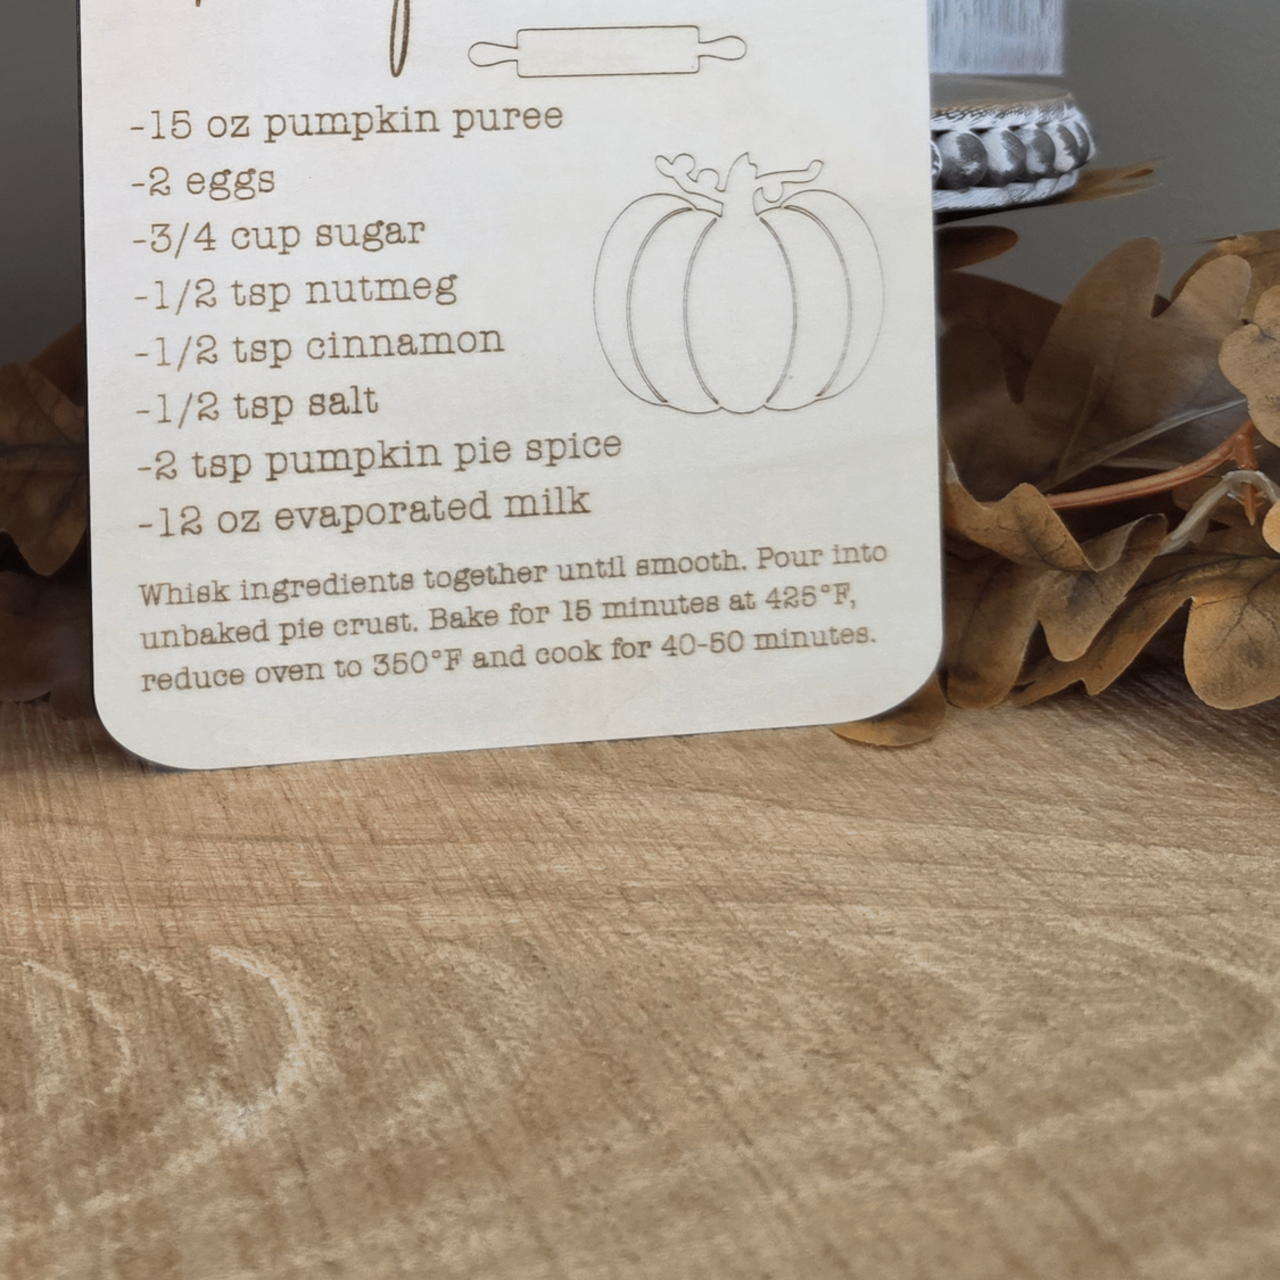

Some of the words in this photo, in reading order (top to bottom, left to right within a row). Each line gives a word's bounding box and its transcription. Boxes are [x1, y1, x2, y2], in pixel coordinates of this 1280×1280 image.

[206, 114, 251, 139] oz
[263, 103, 441, 144] pumpkin
[451, 106, 564, 139] puree
[186, 167, 276, 202] eggs
[230, 224, 301, 256] cup
[315, 219, 426, 253] sugar
[230, 279, 291, 313] tsp
[304, 273, 459, 306] nutmeg
[231, 336, 293, 369] tsp
[306, 329, 506, 361] cinnamon
[232, 392, 294, 425] tsp
[308, 384, 379, 417] salt
[190, 451, 253, 485] tsp
[264, 439, 443, 483] pumpkin
[453, 435, 512, 473] pie
[525, 432, 623, 465] spice
[217, 509, 261, 535] oz
[274, 489, 493, 535] evaporated
[503, 485, 592, 519] milk
[137, 579, 232, 607] Whisk
[239, 570, 415, 605] ingredients
[422, 561, 550, 593] together
[555, 554, 627, 582] until
[635, 548, 748, 577] smooth.
[756, 546, 824, 570] Pour
[831, 543, 888, 566] into
[139, 618, 271, 651] unbaked
[277, 617, 325, 647] pie
[332, 612, 419, 638] crust.
[428, 605, 500, 631] Bake
[508, 602, 551, 626] for
[561, 598, 593, 623] 15
[601, 594, 721, 620] minutes
[728, 590, 757, 612] at
[140, 665, 246, 693] reduce
[254, 662, 326, 685] oven
[333, 658, 363, 679] to
[471, 643, 528, 670] and
[535, 638, 604, 666] cook
[610, 636, 653, 661] for
[660, 629, 745, 658] 40-50
[752, 626, 877, 651] minutes.
